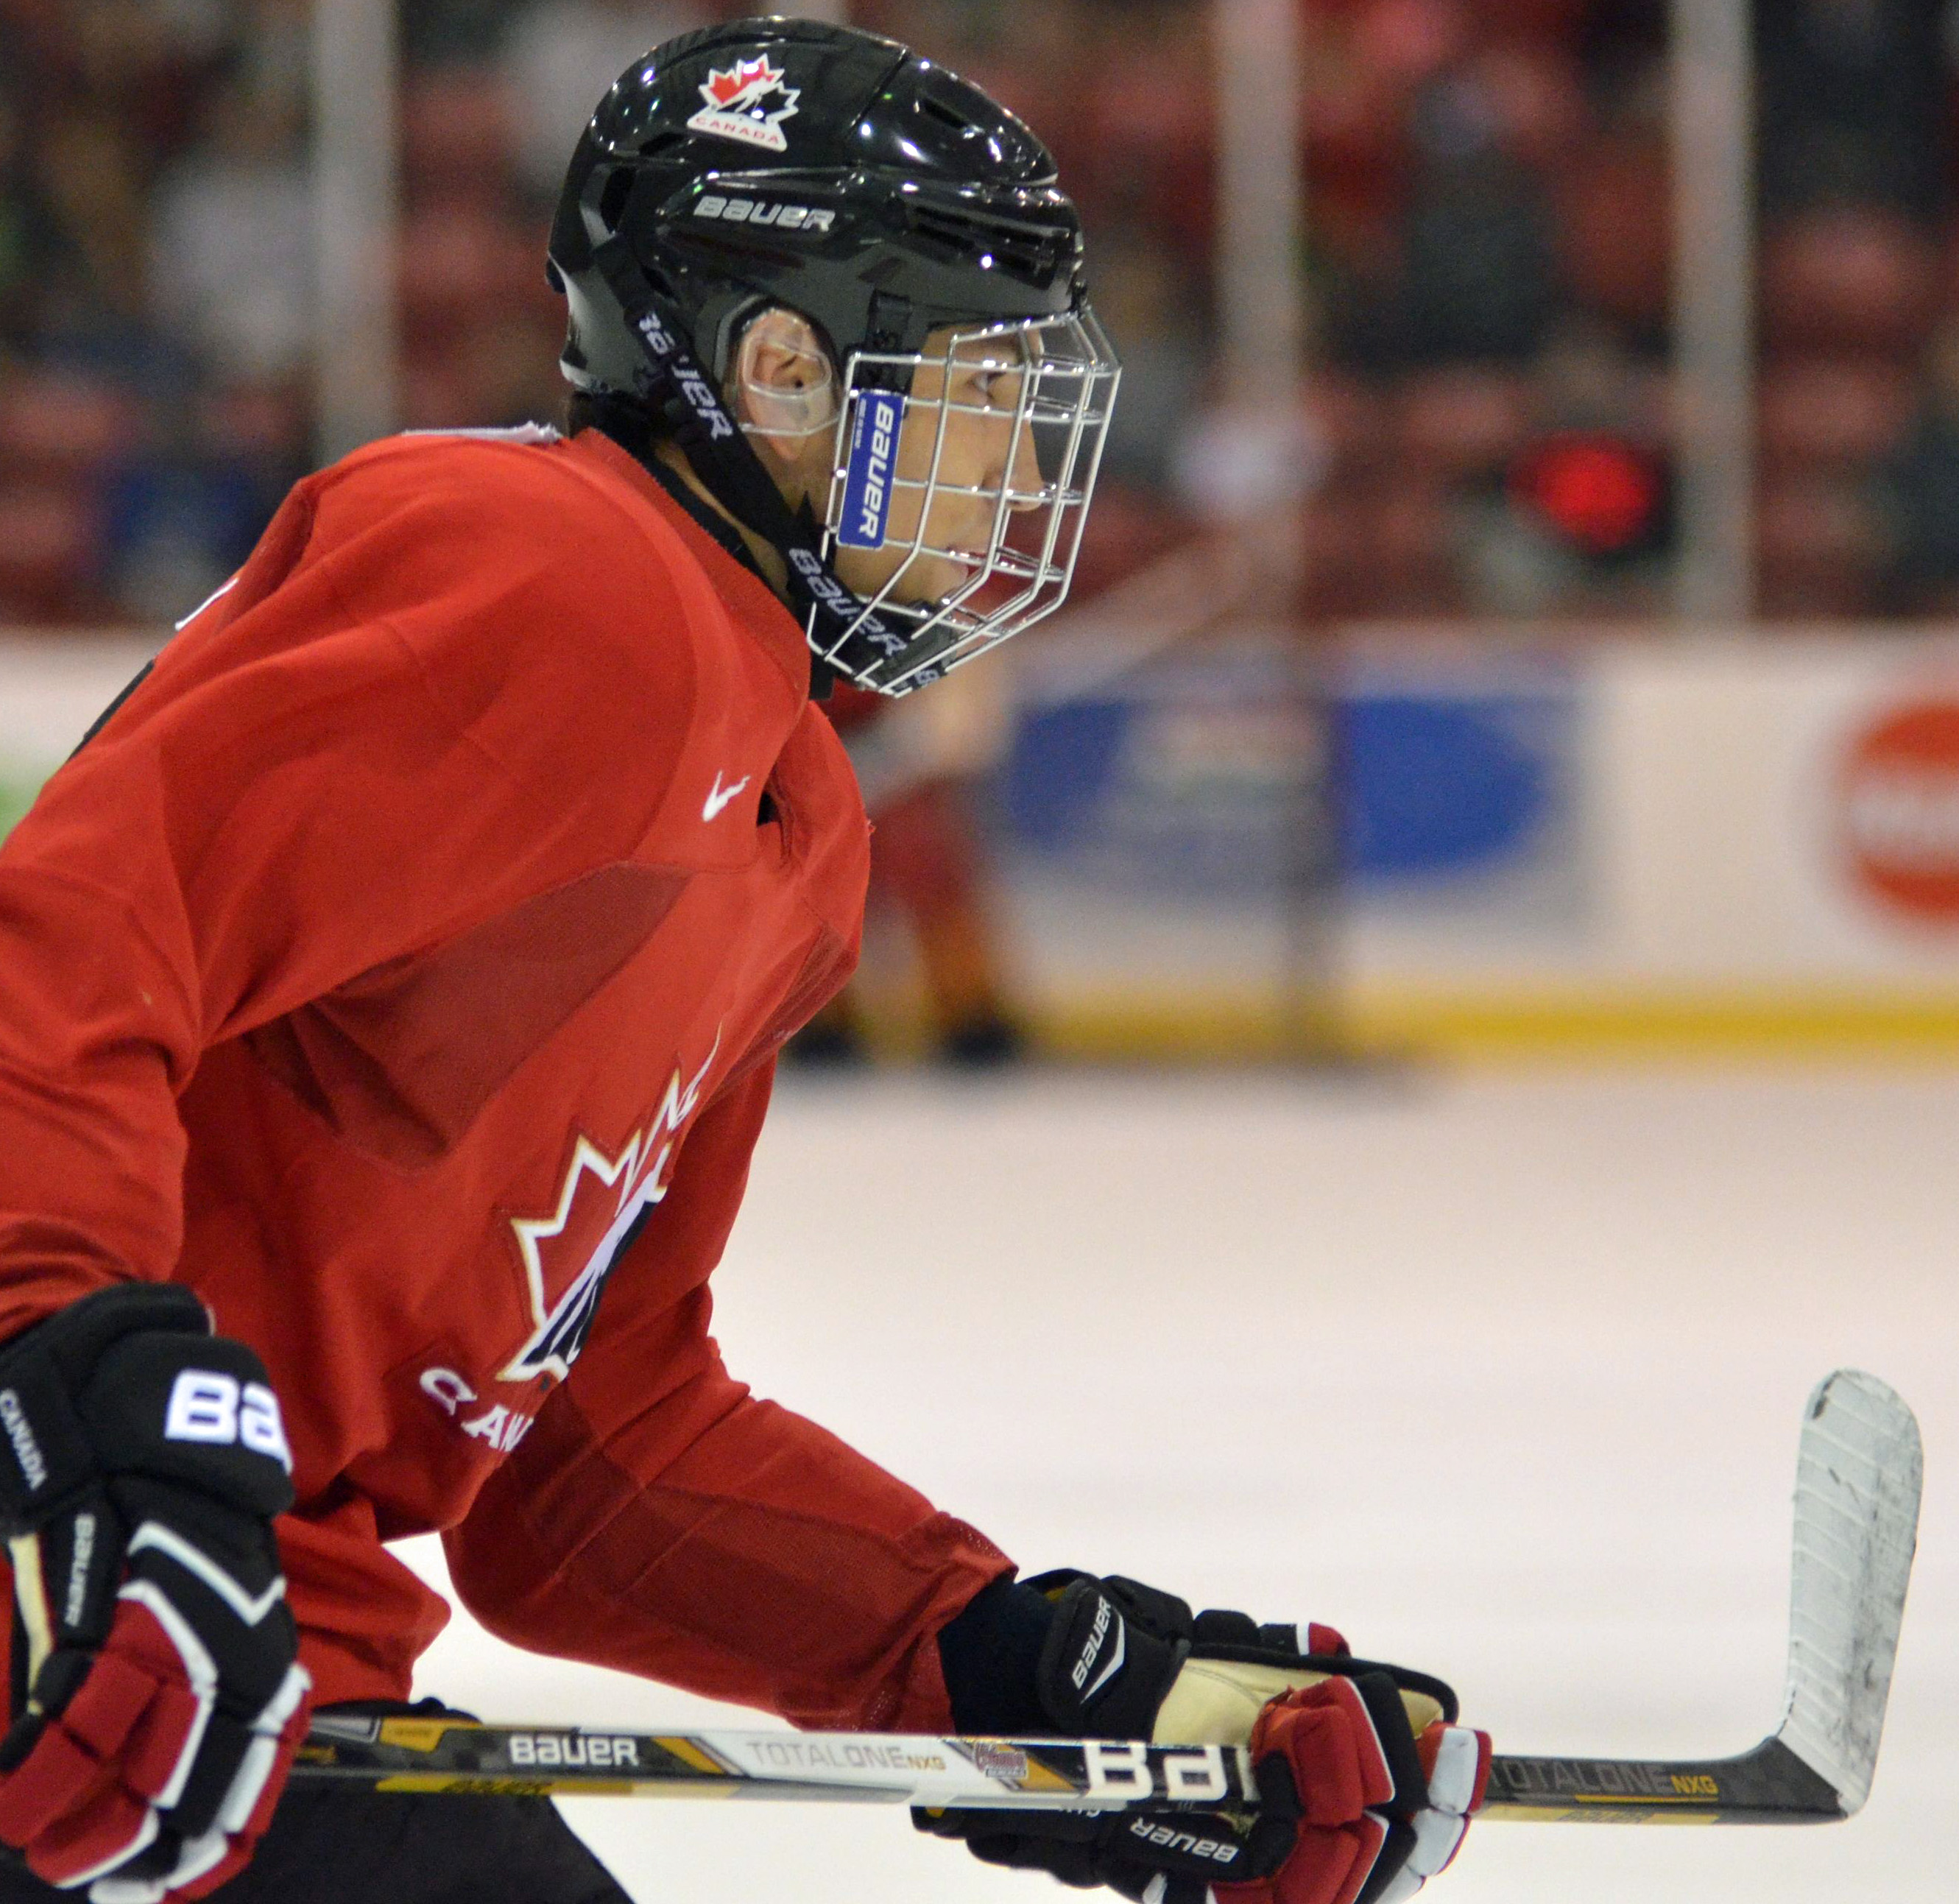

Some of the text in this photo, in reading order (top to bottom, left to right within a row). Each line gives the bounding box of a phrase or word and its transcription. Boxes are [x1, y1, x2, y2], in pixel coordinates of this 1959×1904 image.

[696, 116, 780, 144] CANADA
[693, 195, 836, 232] BAUER
[859, 401, 894, 540] BAUER
[0, 1388, 47, 1491] CANADA
[1071, 1596, 1112, 1690] BAUER
[509, 1734, 639, 1767] BAUER
[1670, 1774, 1719, 1795] NXG
[1130, 1817, 1240, 1864] BAUER
